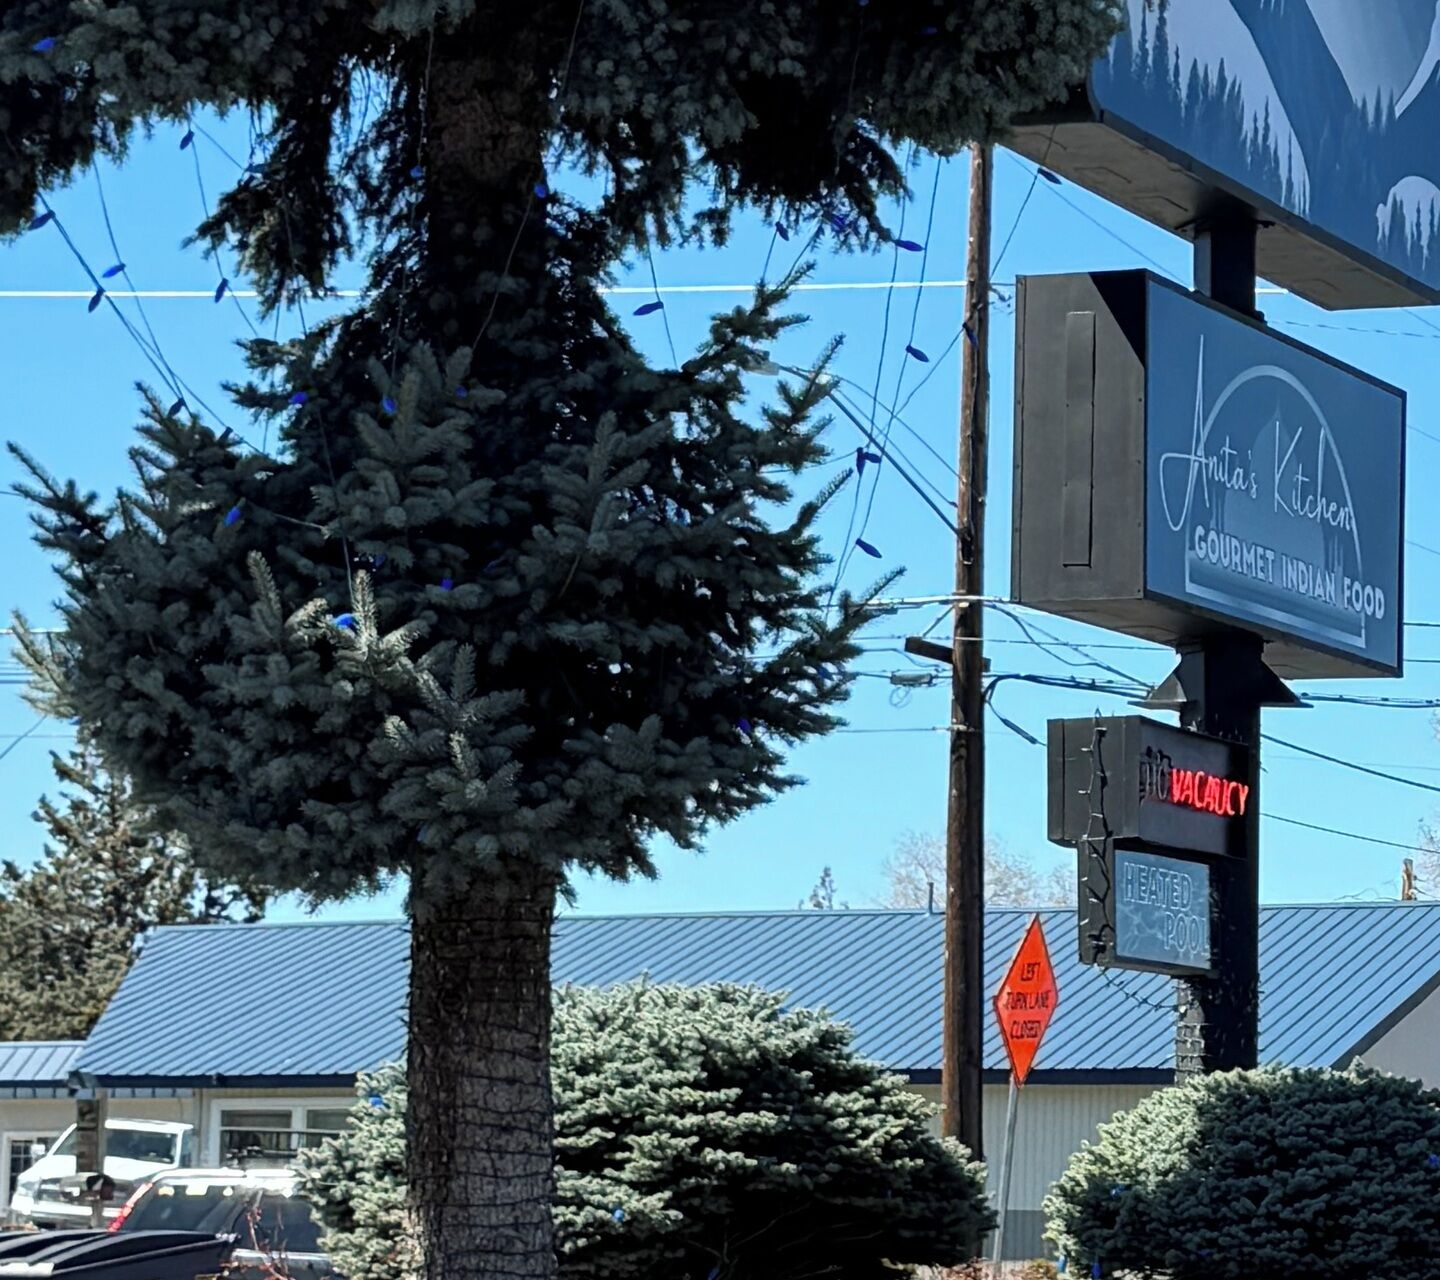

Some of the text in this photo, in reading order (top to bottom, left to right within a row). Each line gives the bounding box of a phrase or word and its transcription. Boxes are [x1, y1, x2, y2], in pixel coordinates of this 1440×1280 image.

[1159, 334, 1353, 533] Anita's Kitchen
[1194, 524, 1386, 620] GOURMET INDIAN FOOD
[1122, 861, 1193, 912] HEATED
[1163, 910, 1210, 957] POOL
